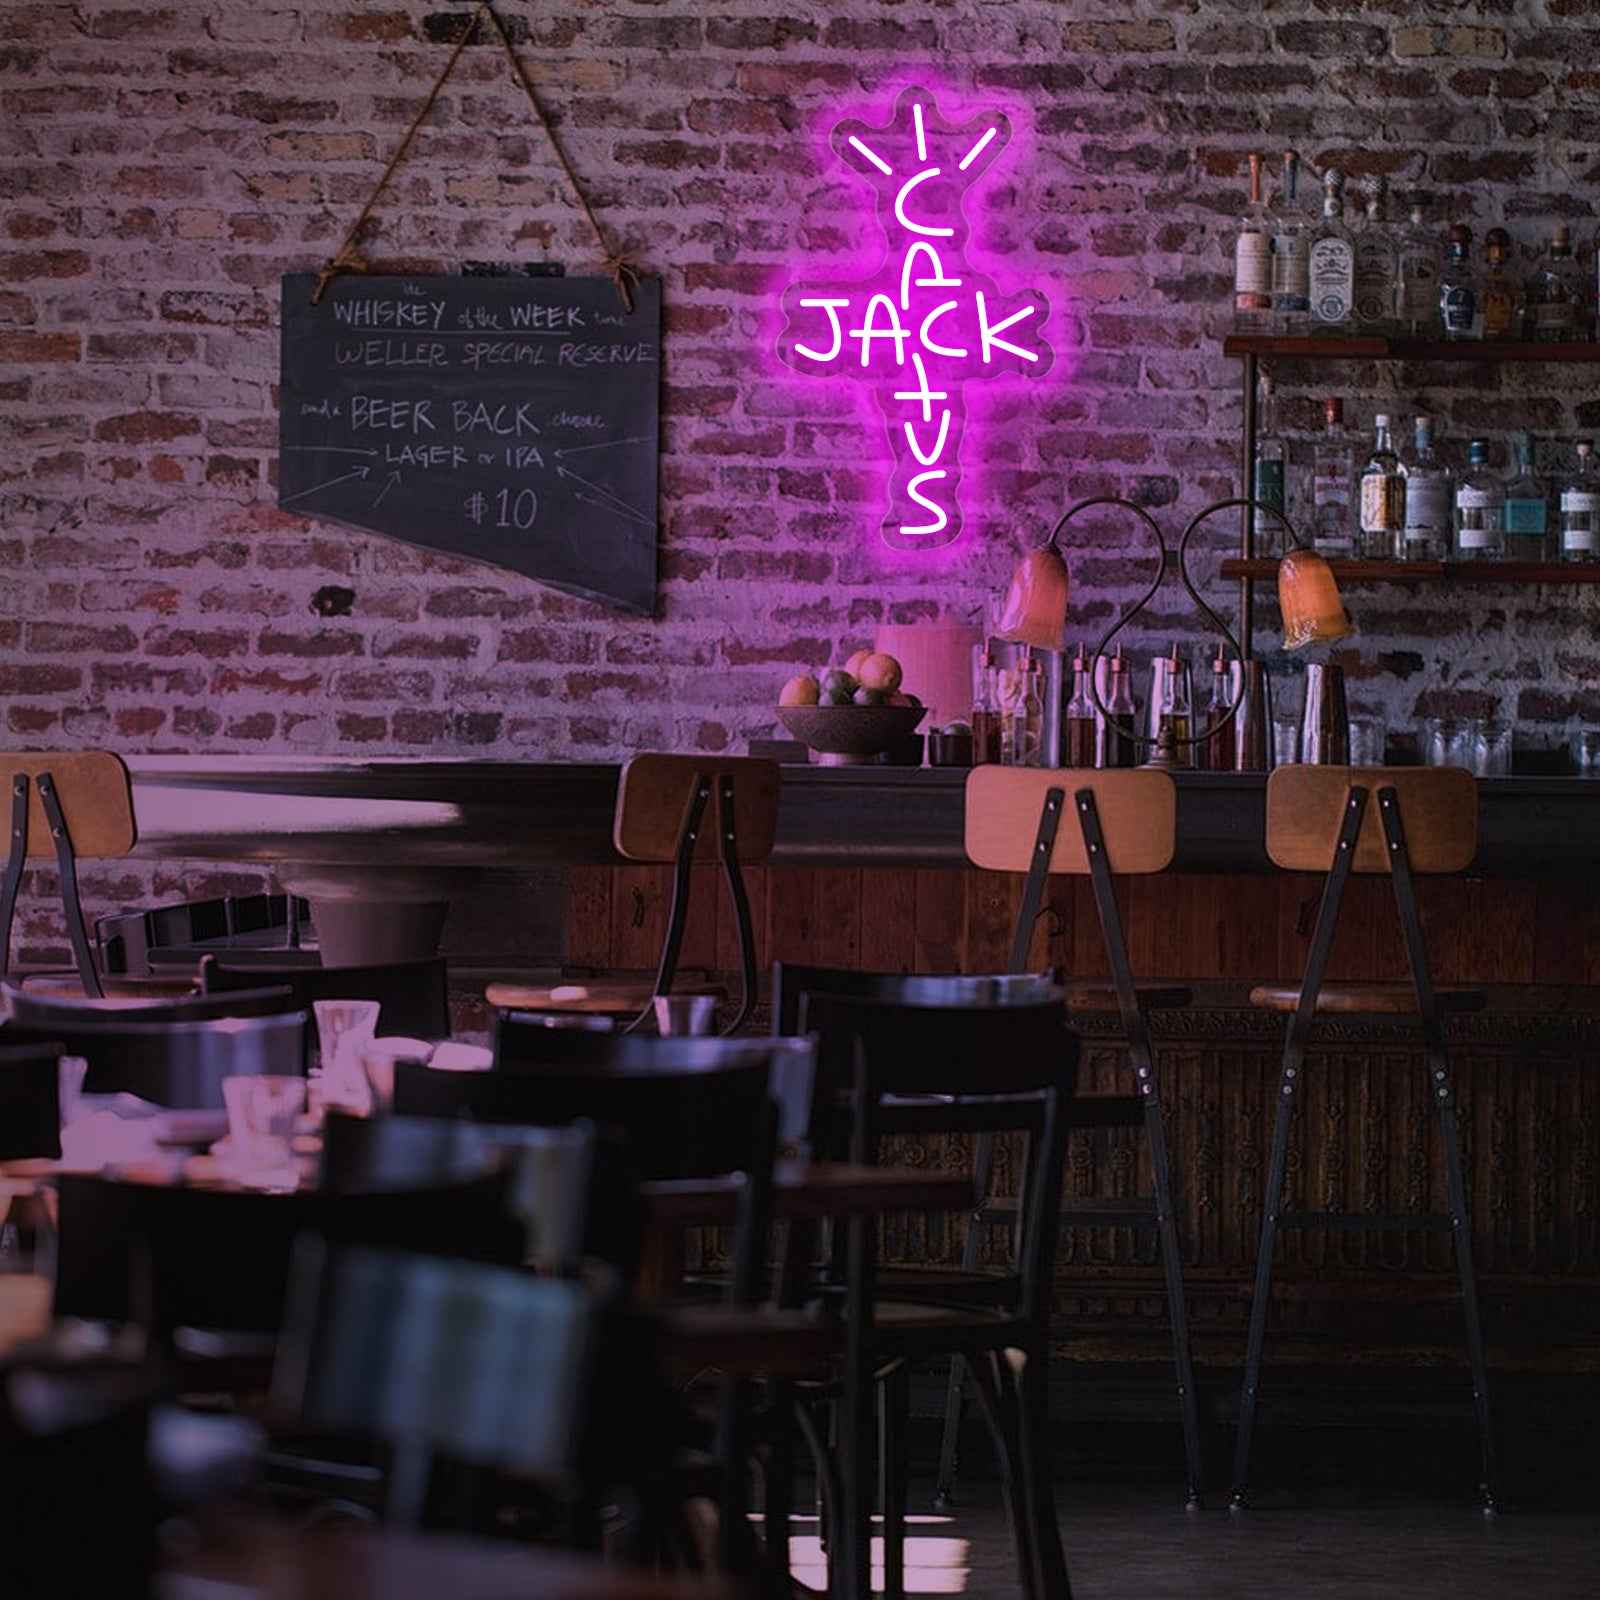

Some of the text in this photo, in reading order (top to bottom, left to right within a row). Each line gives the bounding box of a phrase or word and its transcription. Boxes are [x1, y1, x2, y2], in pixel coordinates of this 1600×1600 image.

[333, 299, 447, 329] WHISKEY
[509, 302, 586, 327] WEEK
[794, 290, 1040, 368] JACK
[335, 339, 657, 371] WELLER SPECIAL RESERVE
[350, 395, 437, 435] BEER
[451, 400, 541, 437] BACK
[384, 443, 545, 469] LAGER or IPA
[464, 487, 538, 529] $10
